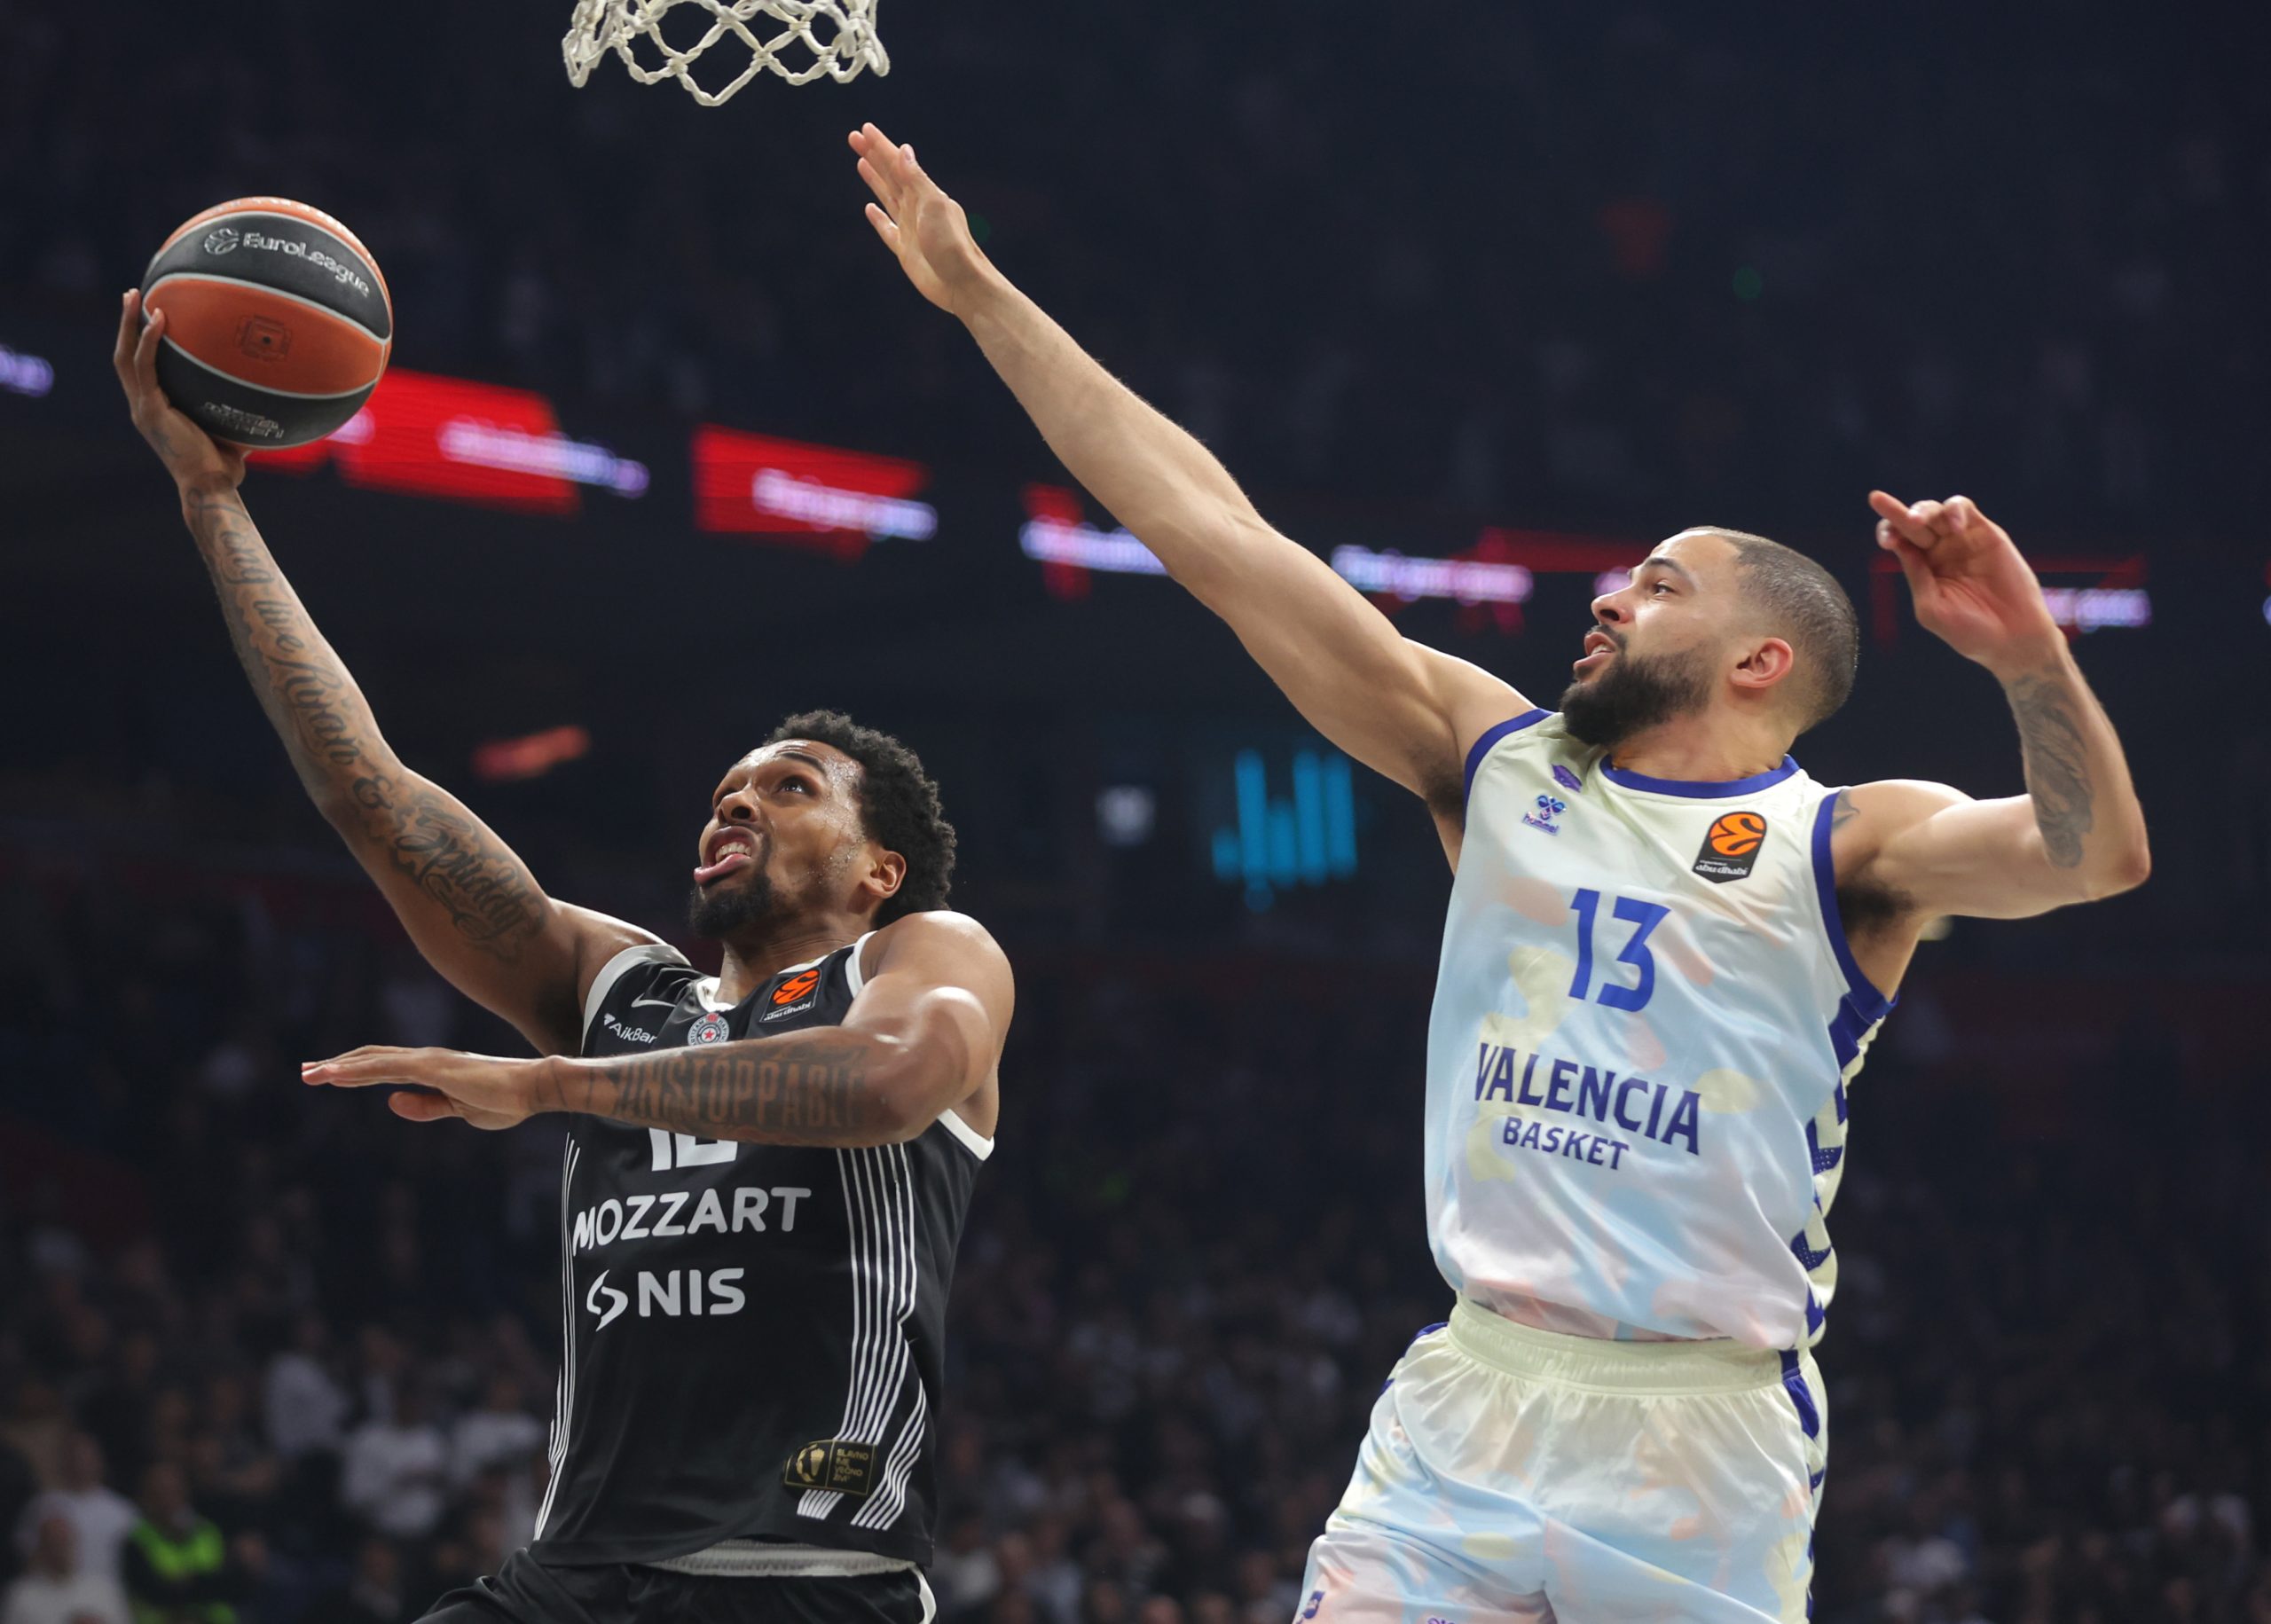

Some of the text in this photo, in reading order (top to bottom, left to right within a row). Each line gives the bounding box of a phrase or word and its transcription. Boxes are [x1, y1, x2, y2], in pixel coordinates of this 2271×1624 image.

[243, 231, 370, 298] EuroLeague
[1568, 888, 1671, 1013] 13
[1473, 1042, 1701, 1156] VALENCIA
[1503, 1117, 1630, 1170] BASKET
[572, 1187, 812, 1256] MOZZART
[638, 1267, 746, 1317] NIS
